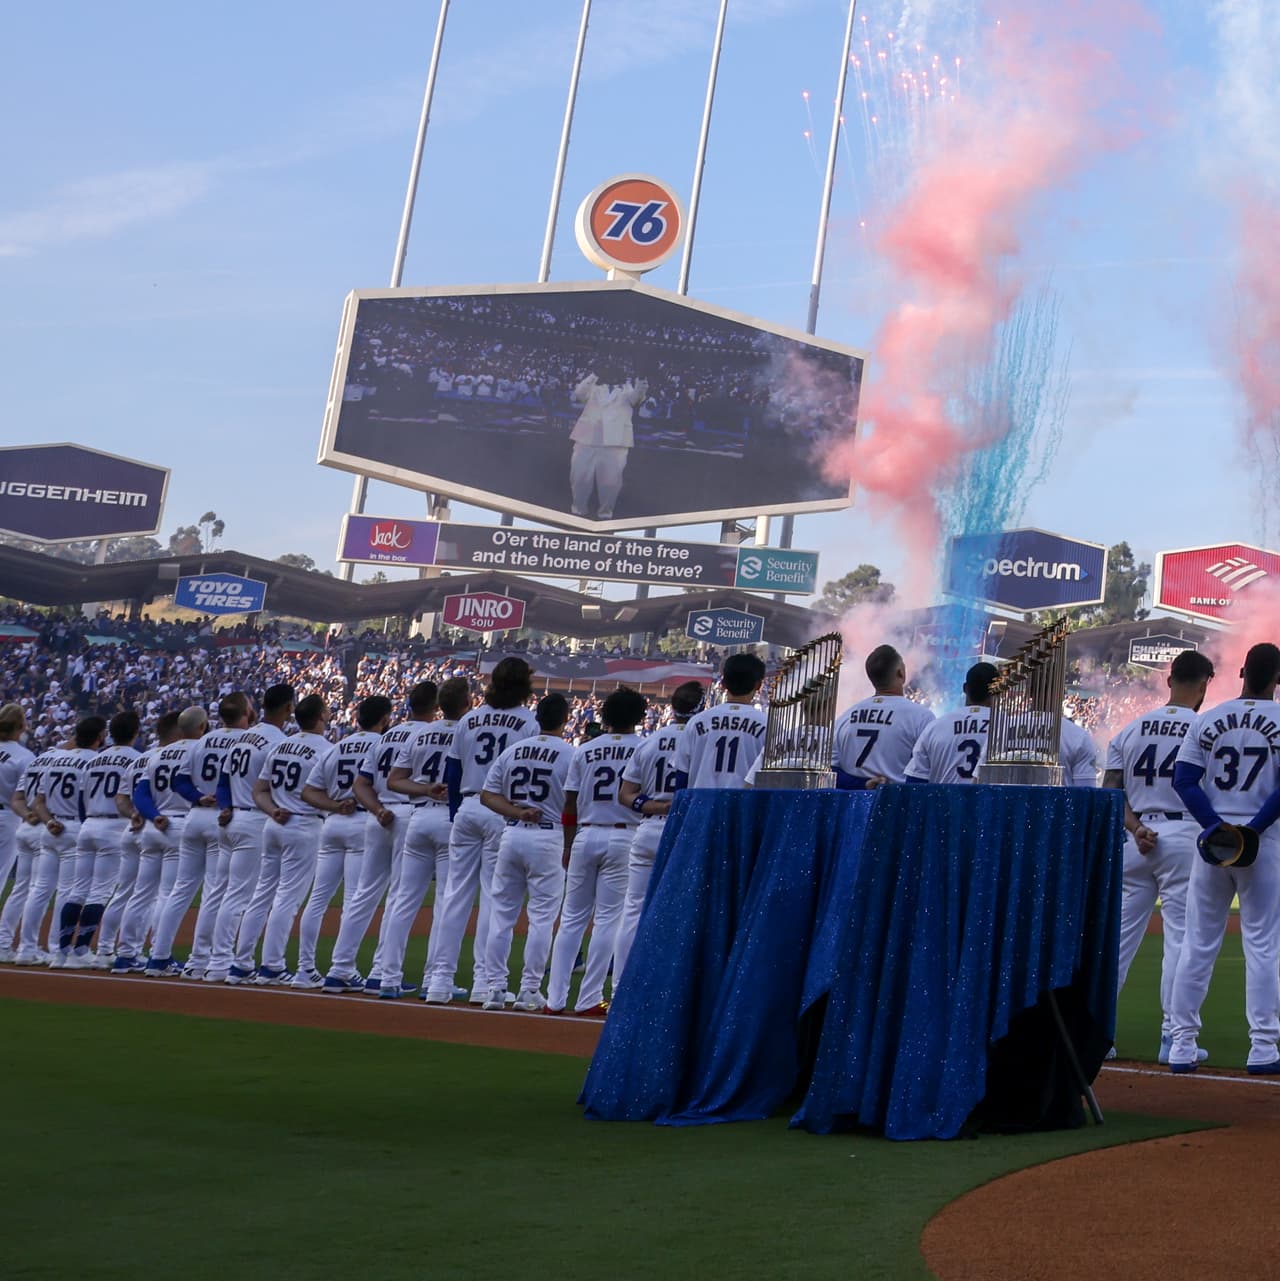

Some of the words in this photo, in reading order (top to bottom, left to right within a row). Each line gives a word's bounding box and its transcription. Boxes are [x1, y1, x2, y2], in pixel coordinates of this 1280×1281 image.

[603, 201, 666, 244] 76
[370, 522, 412, 549] Jack
[532, 534, 560, 549] the
[564, 536, 600, 552] land
[604, 540, 622, 554] of
[626, 541, 653, 557] the
[656, 543, 690, 560] free
[472, 548, 506, 564] and
[510, 551, 538, 566] the
[542, 552, 590, 570] home
[595, 558, 612, 572] of
[616, 559, 643, 574] the
[647, 561, 703, 578] brave?
[766, 557, 813, 573] Security
[967, 554, 1080, 581] pectrum
[188, 580, 244, 595] TOYO
[765, 571, 806, 584] Benefit
[194, 593, 254, 608] TIRES
[456, 597, 513, 620] JINRO
[1190, 597, 1217, 606] BANK
[470, 618, 494, 628] SOJU
[715, 627, 750, 639] Benefit
[716, 616, 757, 630] Security
[468, 713, 526, 732] GLASNOW
[695, 722, 709, 736] R.
[711, 716, 766, 739] SASAKI
[850, 709, 895, 725] SNELL
[954, 715, 990, 735] DÍAZ
[1140, 720, 1190, 738] PAGES
[514, 746, 560, 764] EDMAN
[715, 736, 740, 773] 11
[856, 729, 880, 768] 7
[957, 739, 981, 779] 3
[230, 748, 251, 778] 60
[271, 759, 302, 791] 59
[378, 747, 400, 778] 4
[1214, 746, 1268, 792] 37
[26, 771, 44, 798] 7
[49, 772, 77, 799] 76
[90, 771, 121, 798] 70
[510, 766, 553, 802] 25
